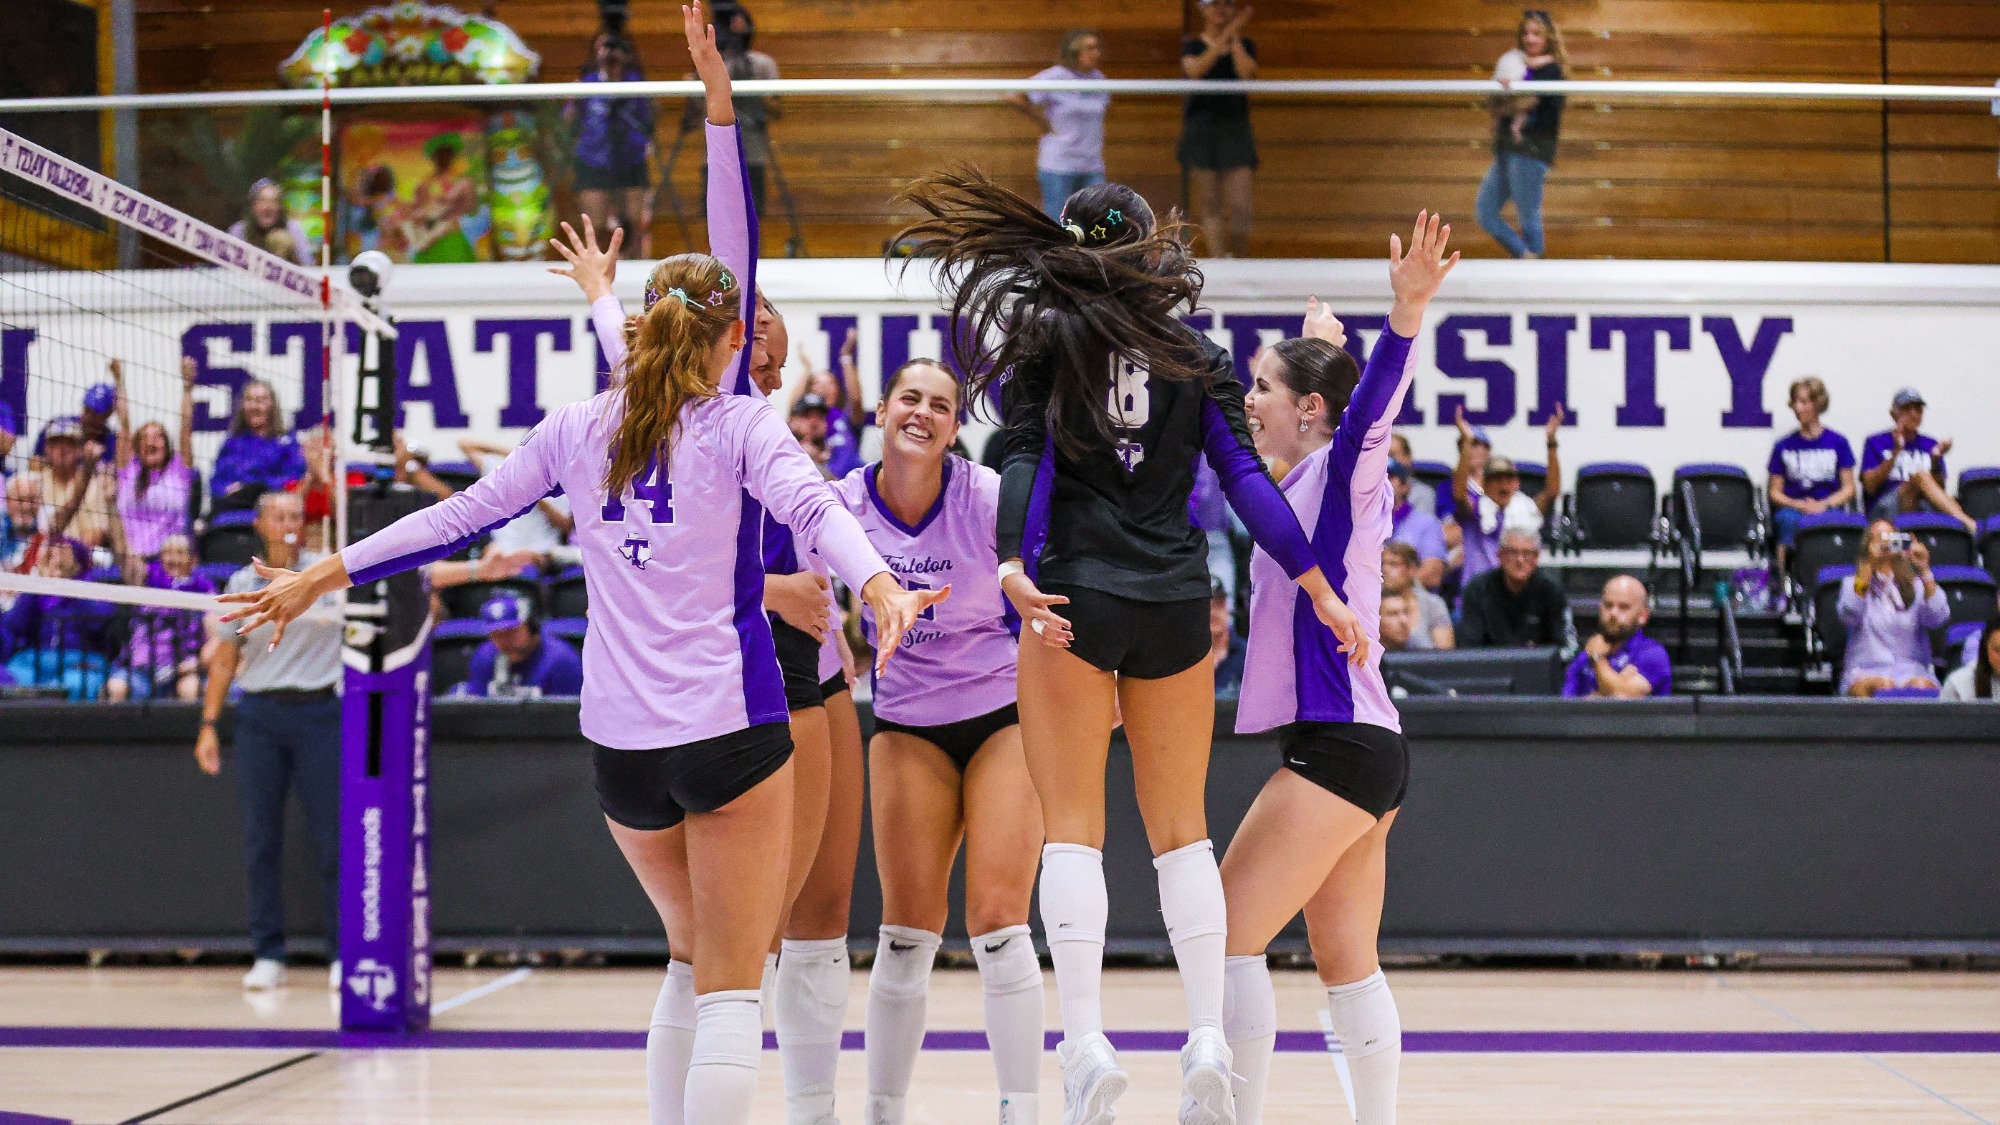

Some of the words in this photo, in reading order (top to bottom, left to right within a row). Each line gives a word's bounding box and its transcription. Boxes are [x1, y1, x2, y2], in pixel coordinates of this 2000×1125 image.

[182, 318, 613, 431] STAT
[1107, 347, 1150, 429] 8
[882, 553, 954, 574] Tarleton
